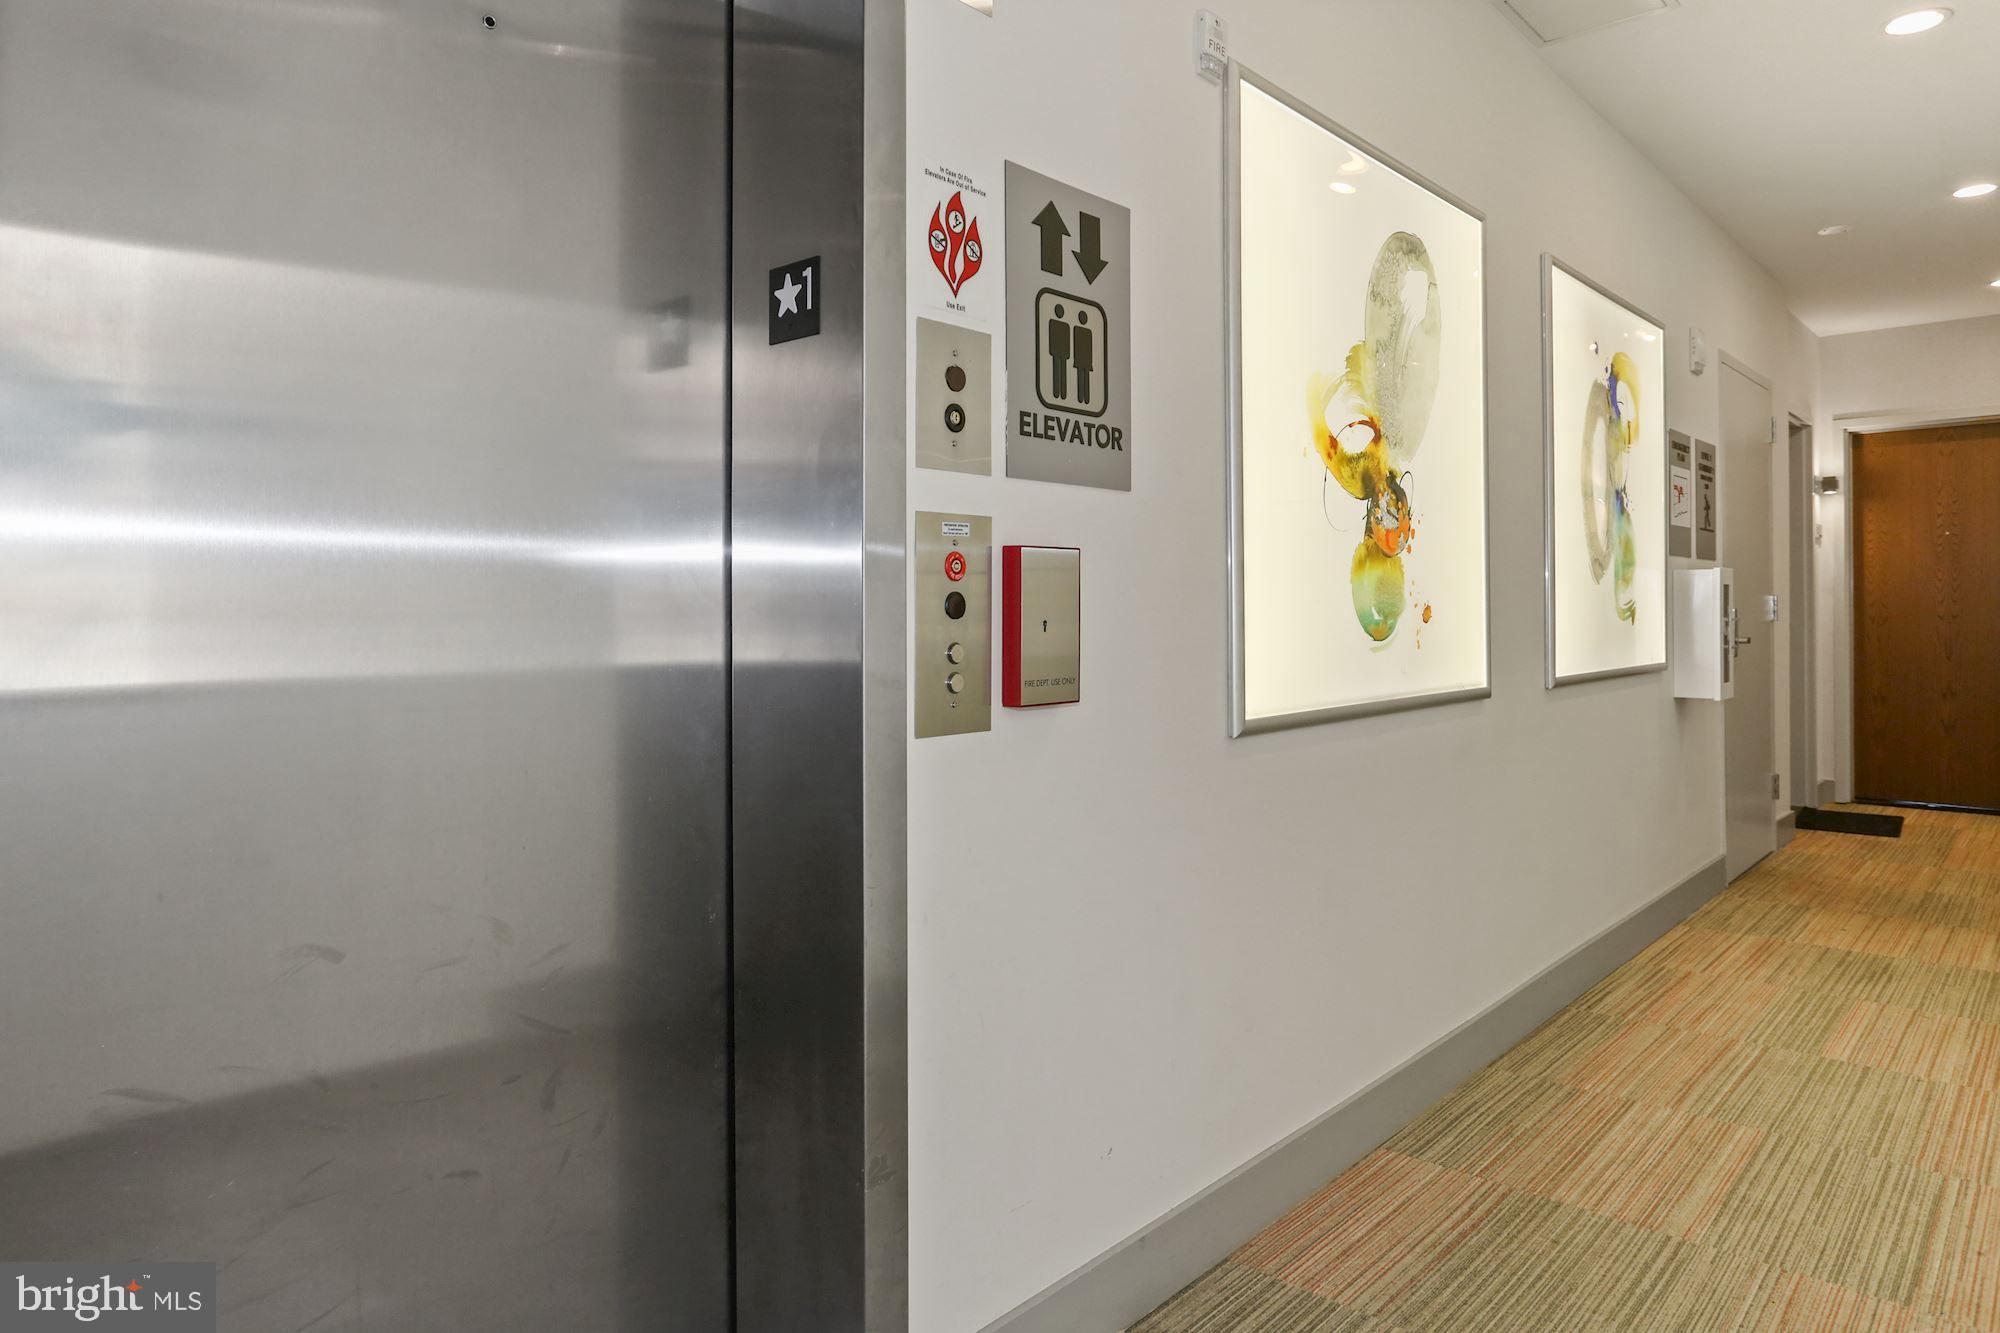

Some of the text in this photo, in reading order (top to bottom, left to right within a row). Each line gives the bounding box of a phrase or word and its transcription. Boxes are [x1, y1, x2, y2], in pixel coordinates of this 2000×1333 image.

[1208, 38, 1226, 57] FIRE
[945, 168, 957, 178] Case
[970, 185, 986, 197] Service
[802, 266, 812, 310] 1
[1019, 410, 1123, 452] ELEVATOR
[1024, 680, 1036, 688] FIRE
[1050, 678, 1062, 686] USE
[1062, 677, 1076, 685] ONLY
